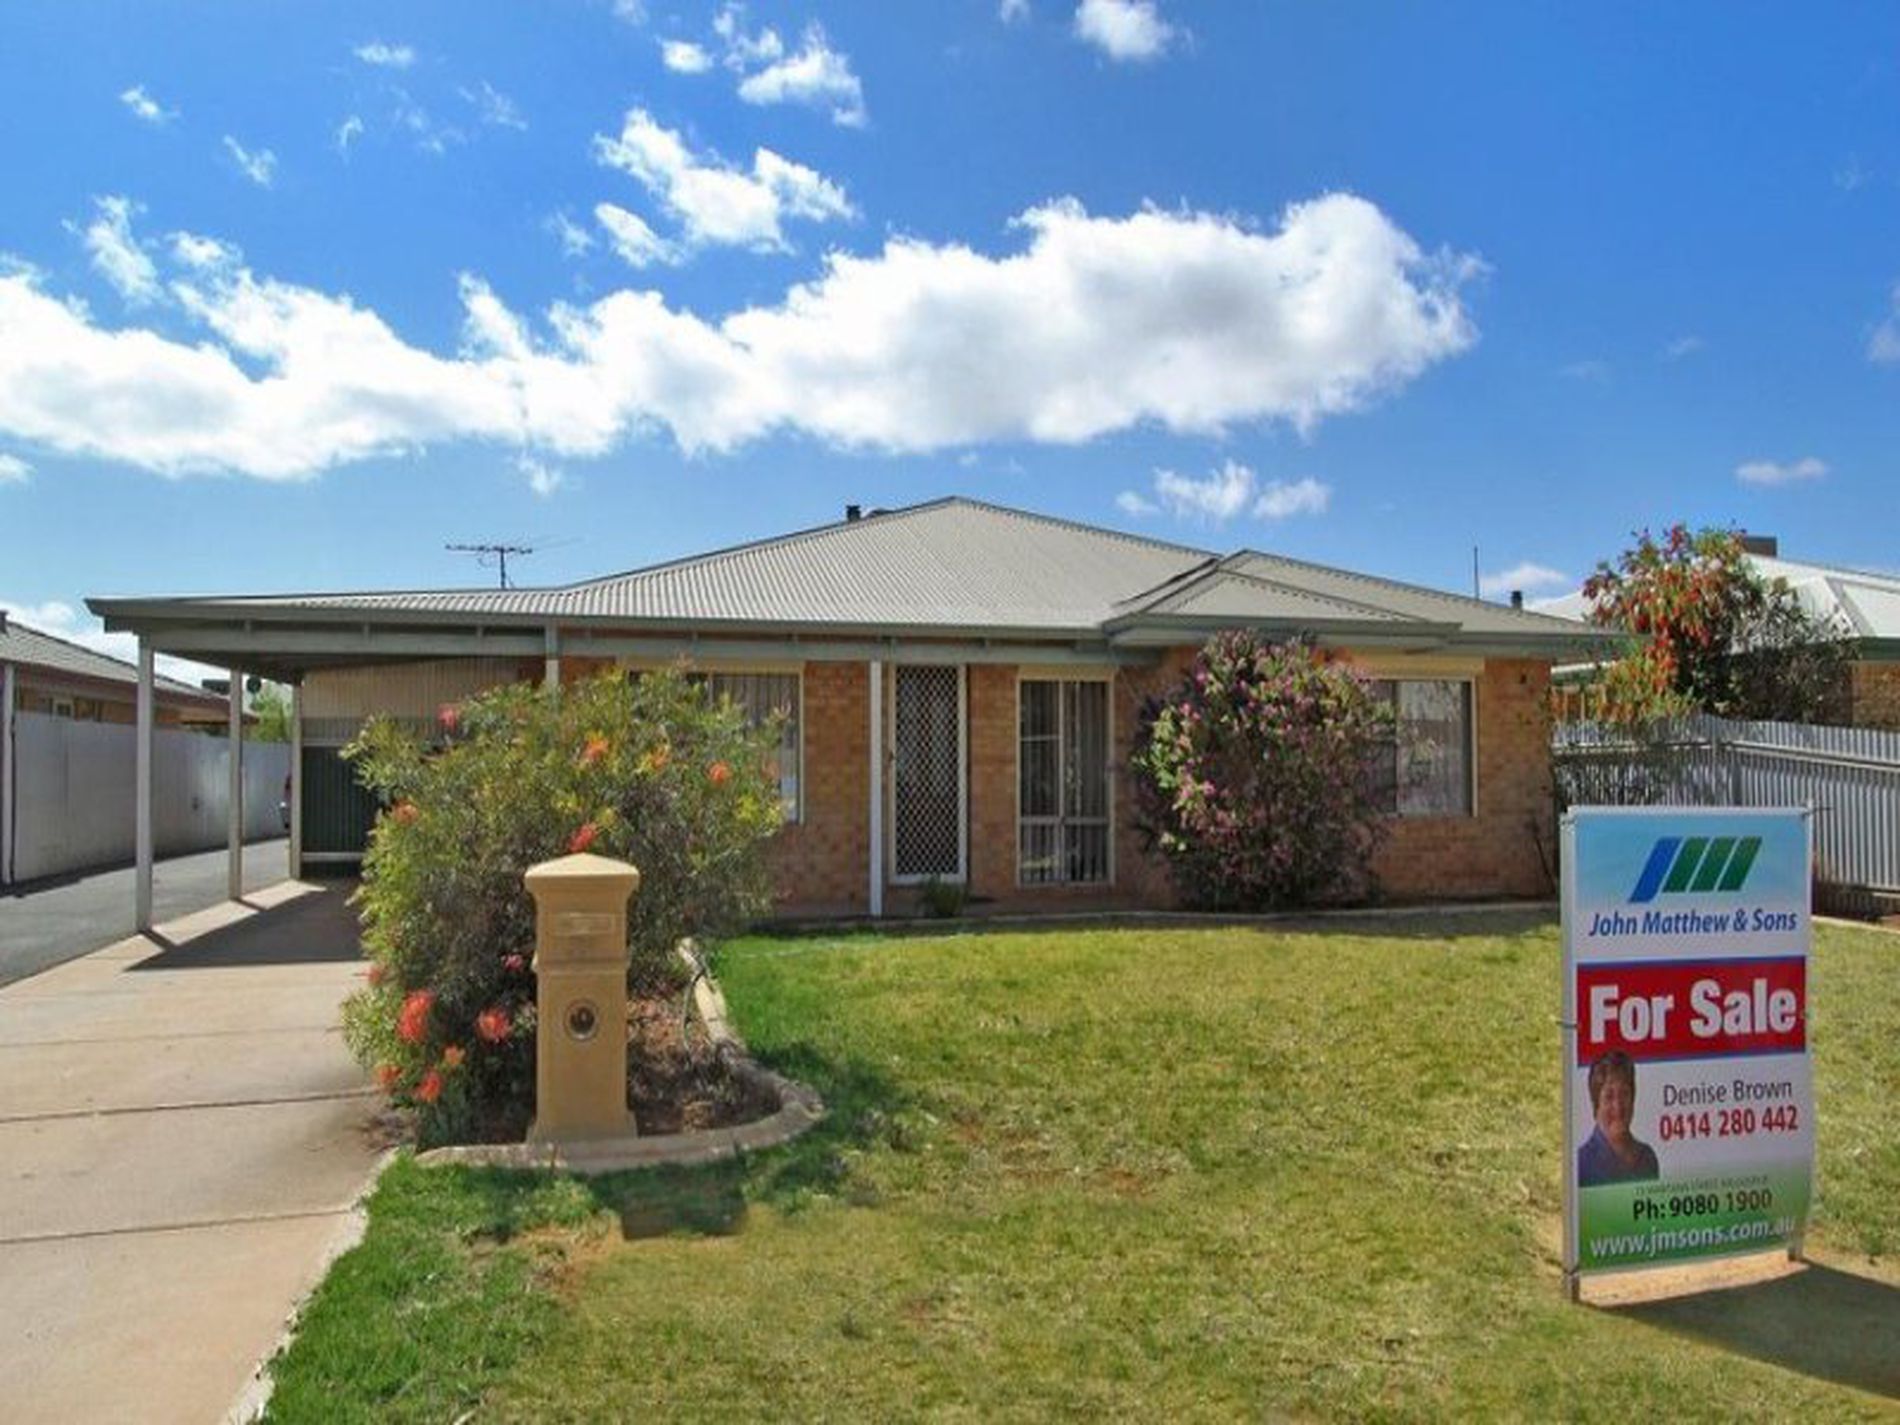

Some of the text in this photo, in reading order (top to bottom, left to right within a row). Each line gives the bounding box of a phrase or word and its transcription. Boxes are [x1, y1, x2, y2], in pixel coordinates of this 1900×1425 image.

[1589, 908, 1798, 937] John Matthew & Sons
[1590, 978, 1797, 1043] For Sale
[1663, 1079, 1793, 1107] Denise Brown
[1659, 1105, 1799, 1141] 0414 280 442
[1633, 1189, 1773, 1221] Ph: 9080 1900
